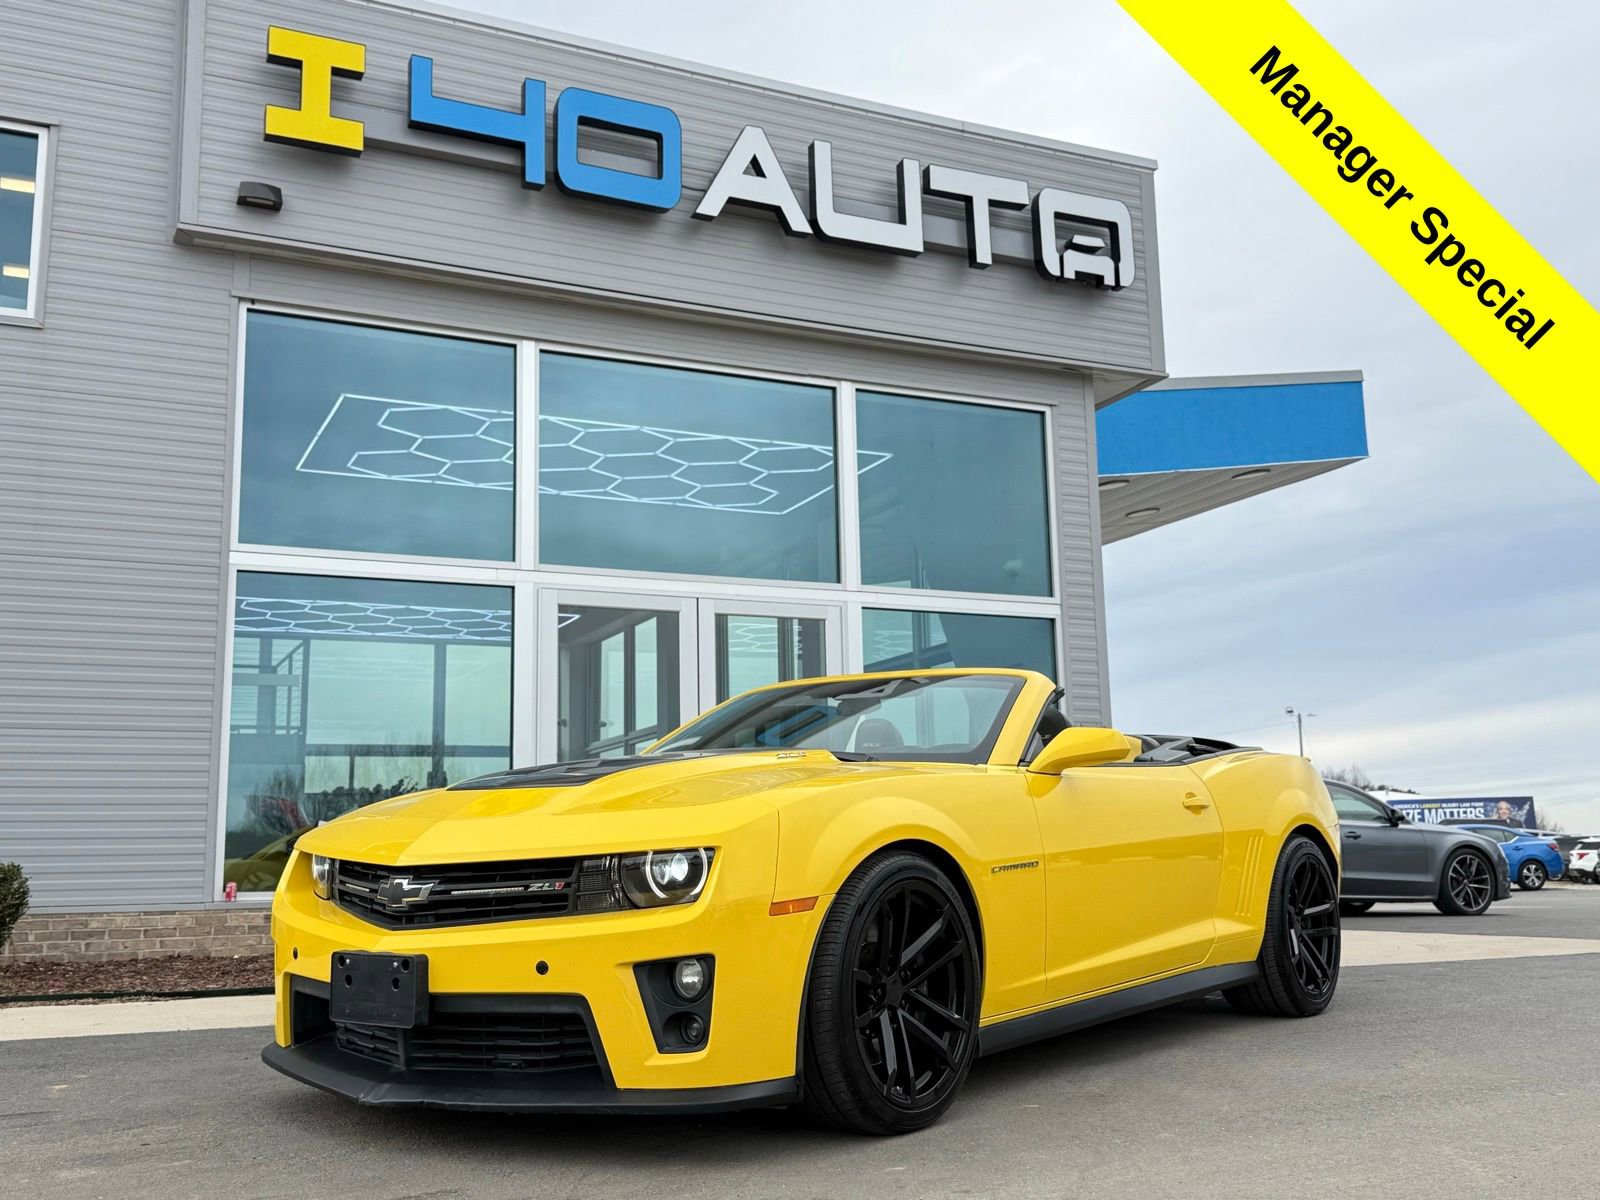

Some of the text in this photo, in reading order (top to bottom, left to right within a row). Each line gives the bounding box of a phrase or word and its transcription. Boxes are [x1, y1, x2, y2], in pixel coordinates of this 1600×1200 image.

[692, 124, 1136, 291] AUTO
[1423, 807, 1485, 824] MATTERS
[991, 860, 1039, 874] CAMARO
[527, 882, 565, 892] ZL1
